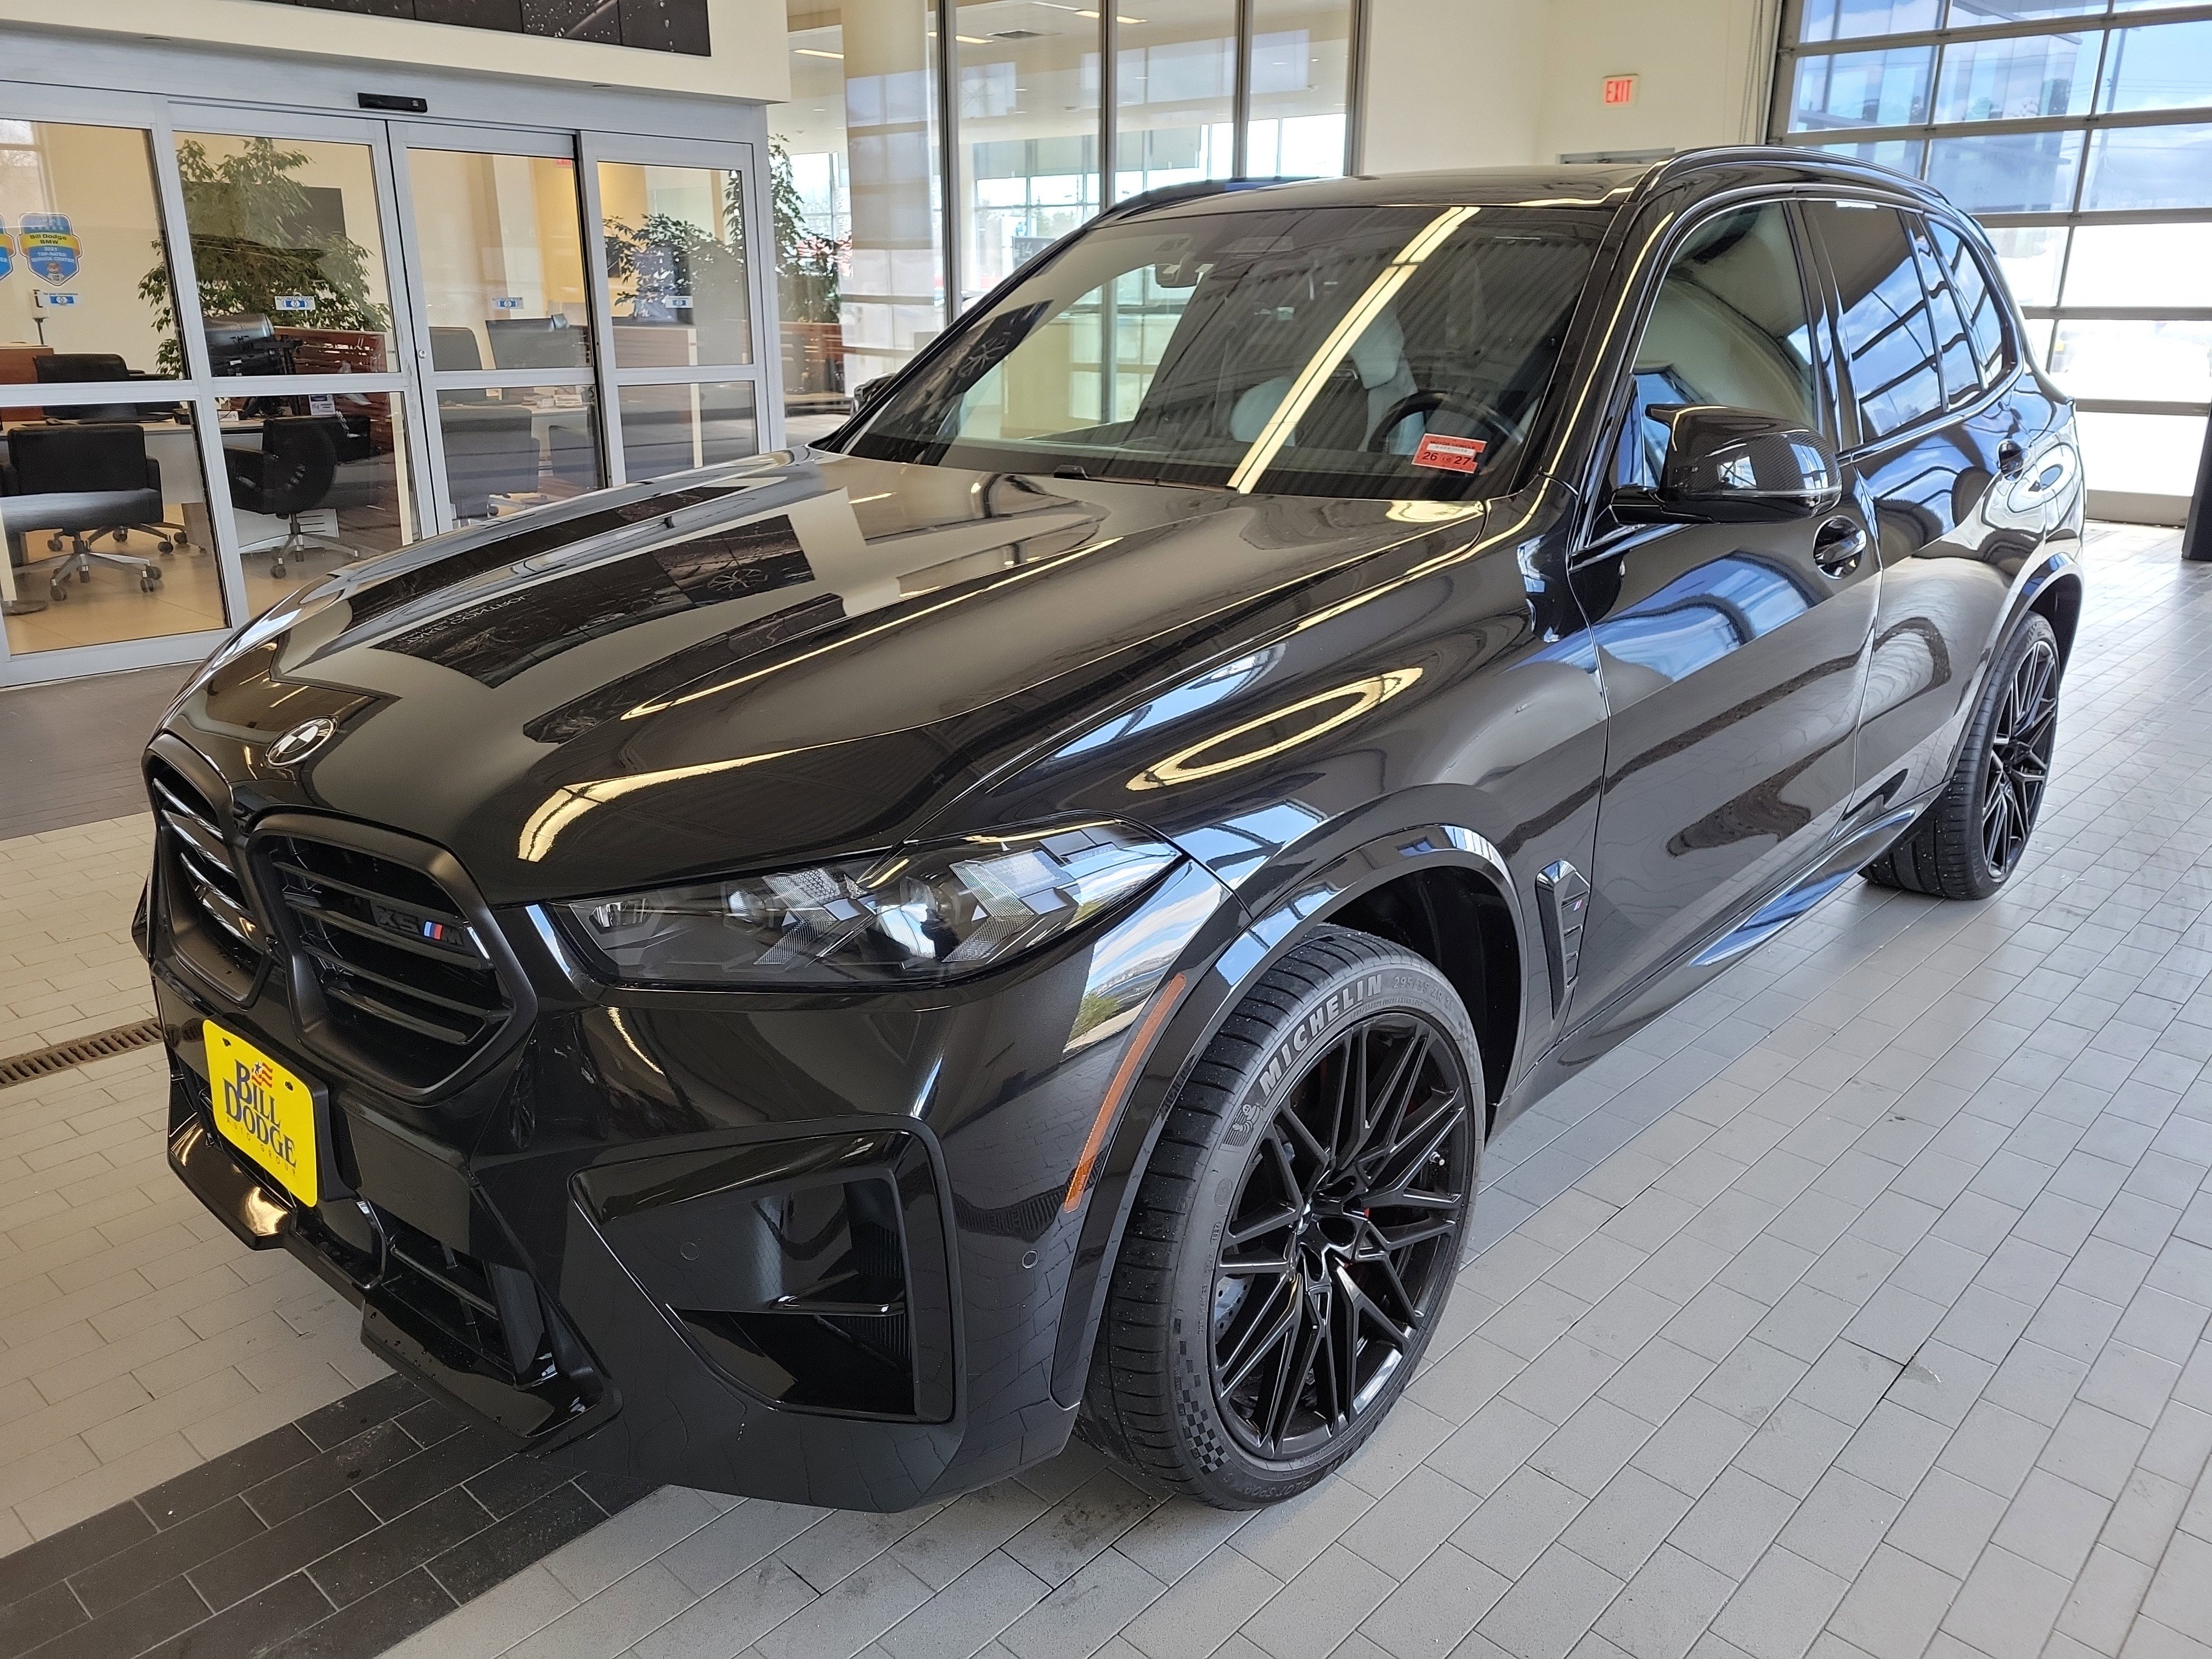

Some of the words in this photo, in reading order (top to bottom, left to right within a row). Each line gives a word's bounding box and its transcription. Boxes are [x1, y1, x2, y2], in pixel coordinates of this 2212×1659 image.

[1606, 80, 1632, 103] EXIT
[1422, 452, 1438, 461] 26
[1454, 456, 1472, 465] 27
[1259, 974, 1381, 1097] MICHELIN
[223, 1077, 297, 1167] DODGE
[235, 1059, 281, 1128] BILL
[227, 1117, 251, 1142] AUTO
[260, 1143, 296, 1176] GROUP
